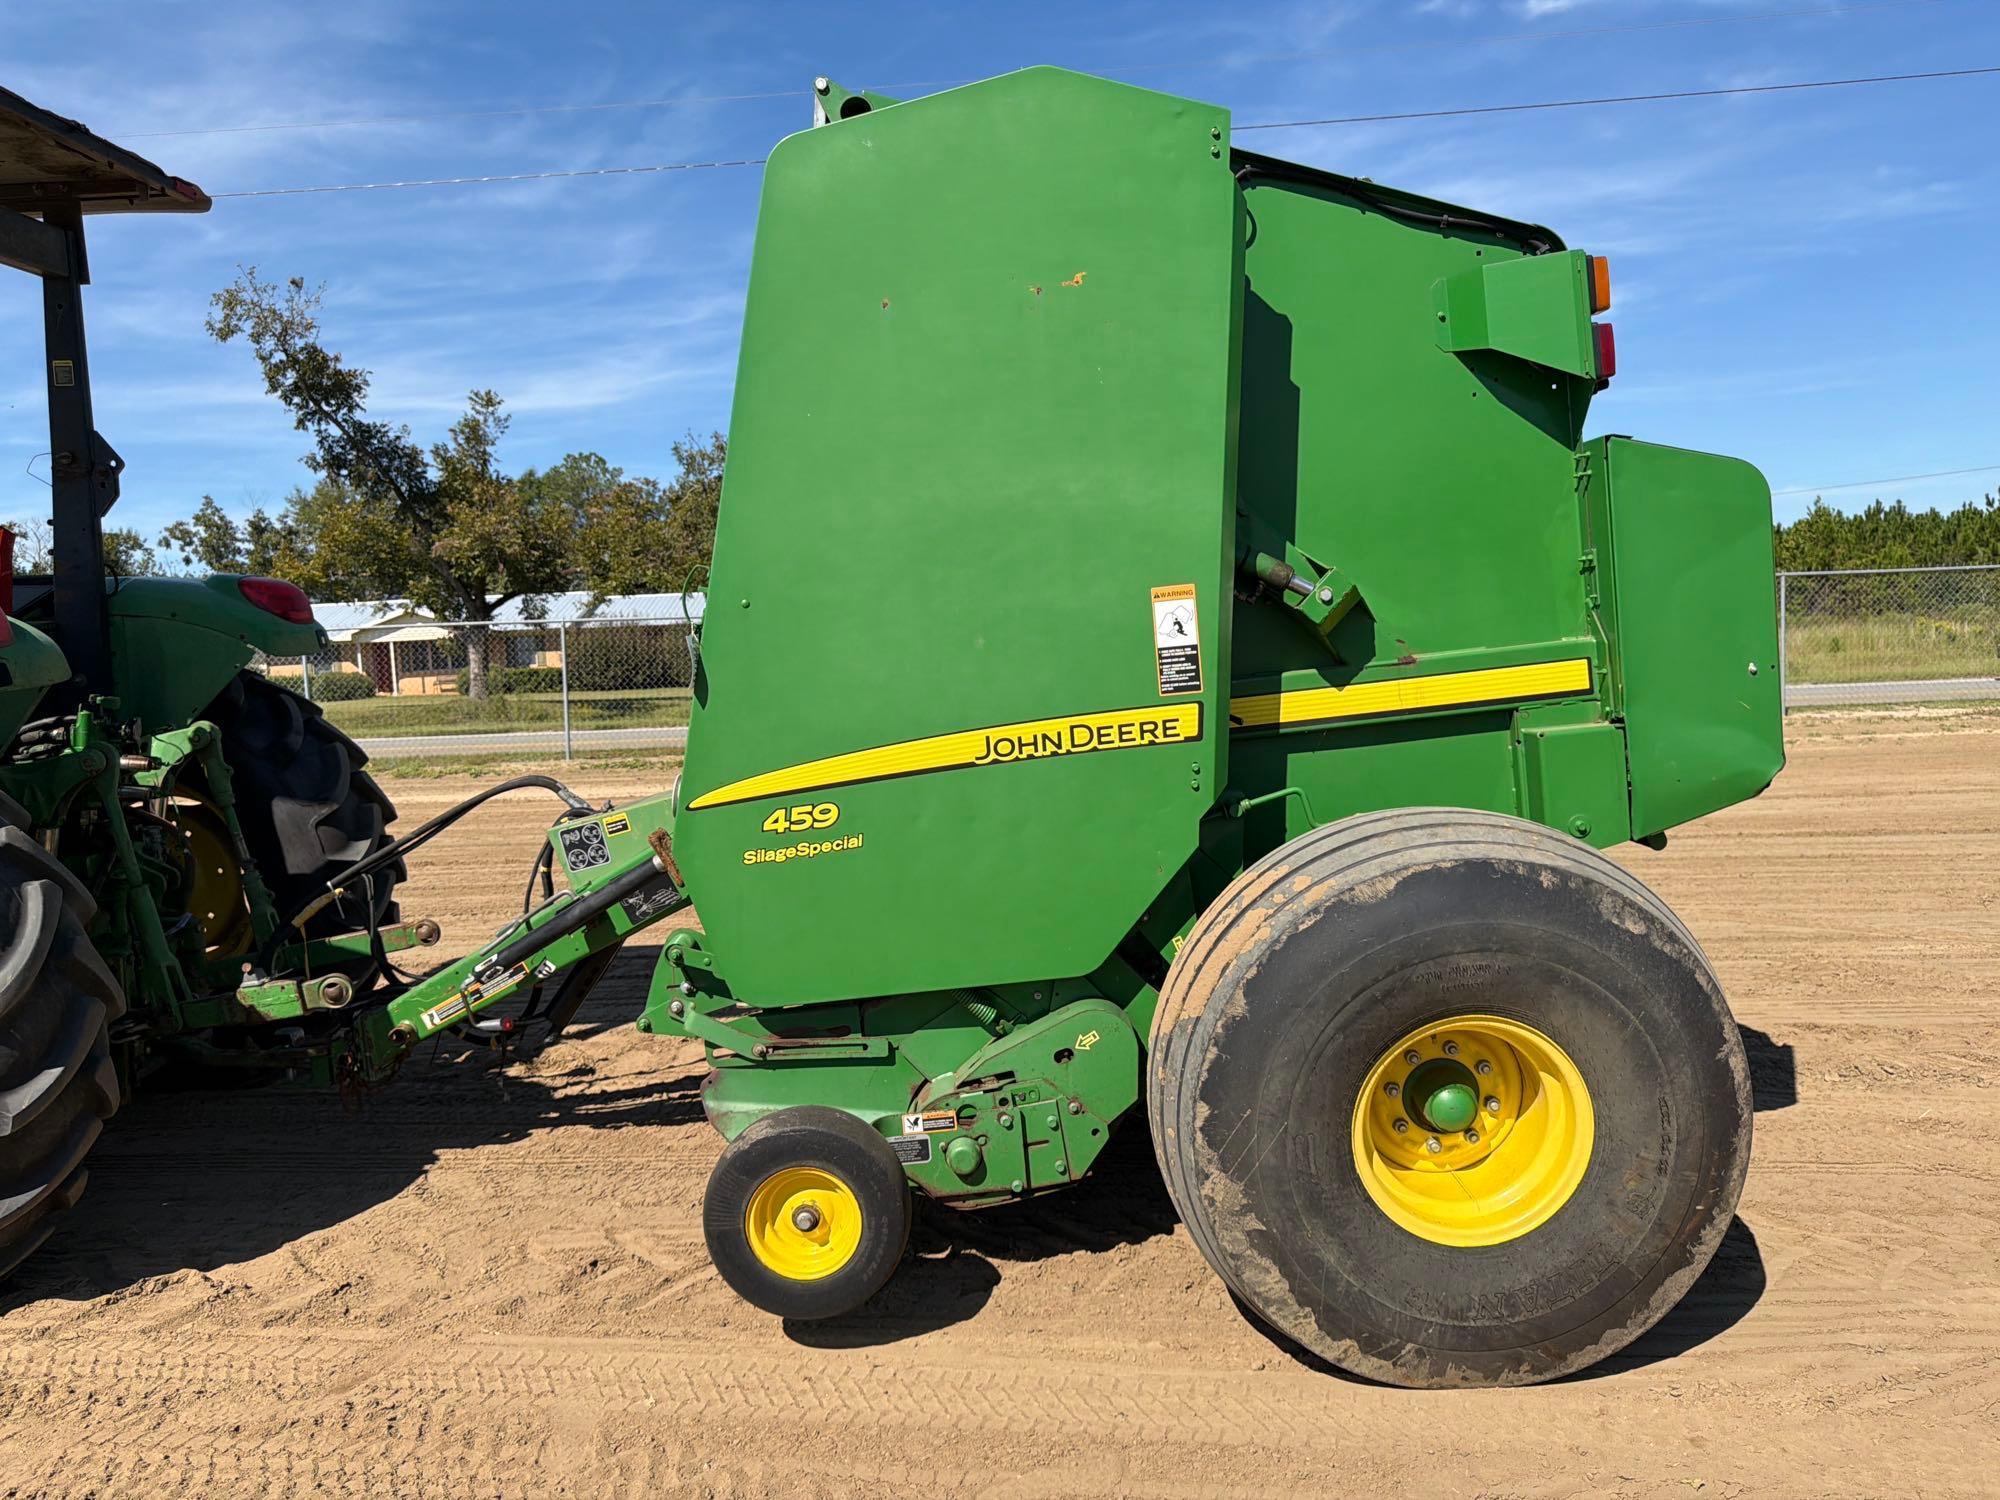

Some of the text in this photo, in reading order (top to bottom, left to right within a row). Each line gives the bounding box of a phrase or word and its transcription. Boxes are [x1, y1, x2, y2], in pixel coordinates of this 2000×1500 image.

[1160, 590, 1194, 598] WARNING
[975, 718, 1181, 762] JOHN DEERE
[761, 802, 840, 834] 459
[742, 833, 864, 866] SilageSpecial
